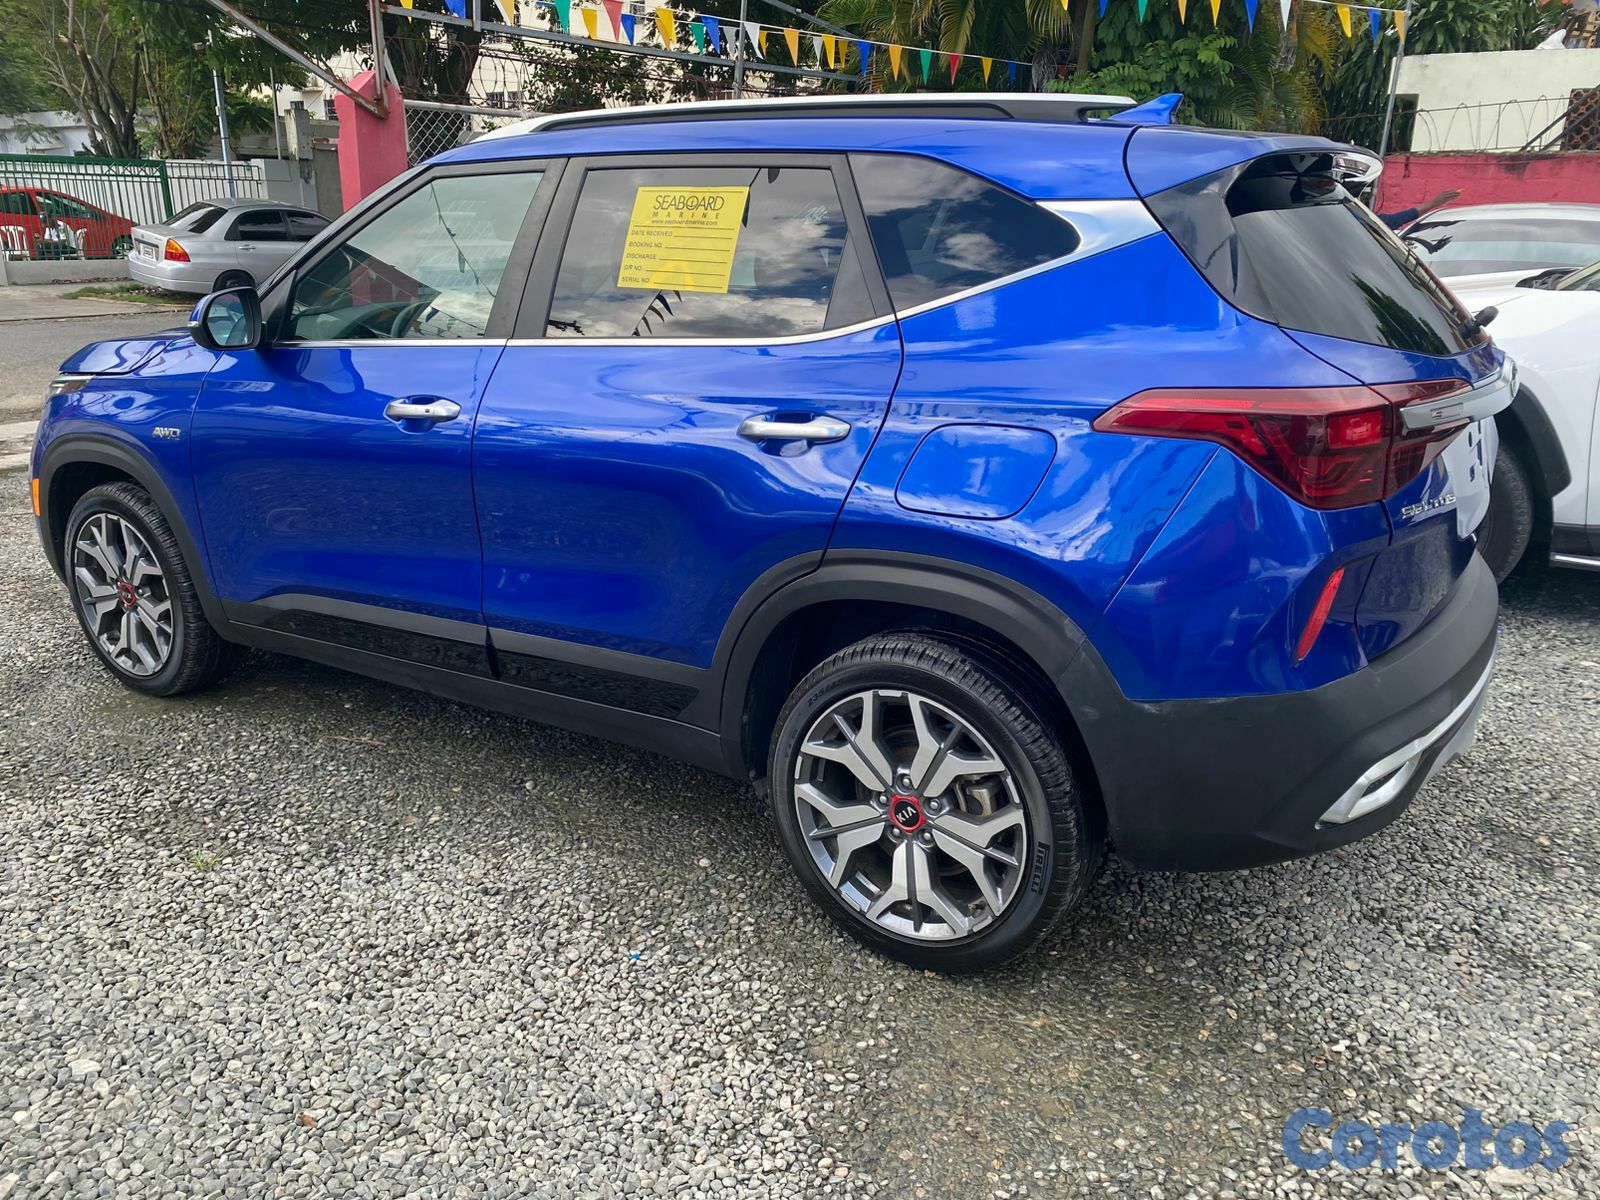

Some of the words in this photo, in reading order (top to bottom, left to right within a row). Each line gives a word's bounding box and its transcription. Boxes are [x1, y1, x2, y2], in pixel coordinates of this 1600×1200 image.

[653, 195, 725, 211] SEABOARD
[652, 211, 720, 219] MARINE
[152, 426, 181, 440] AWD
[896, 806, 917, 823] KIA
[1031, 841, 1050, 895] PIRELLI
